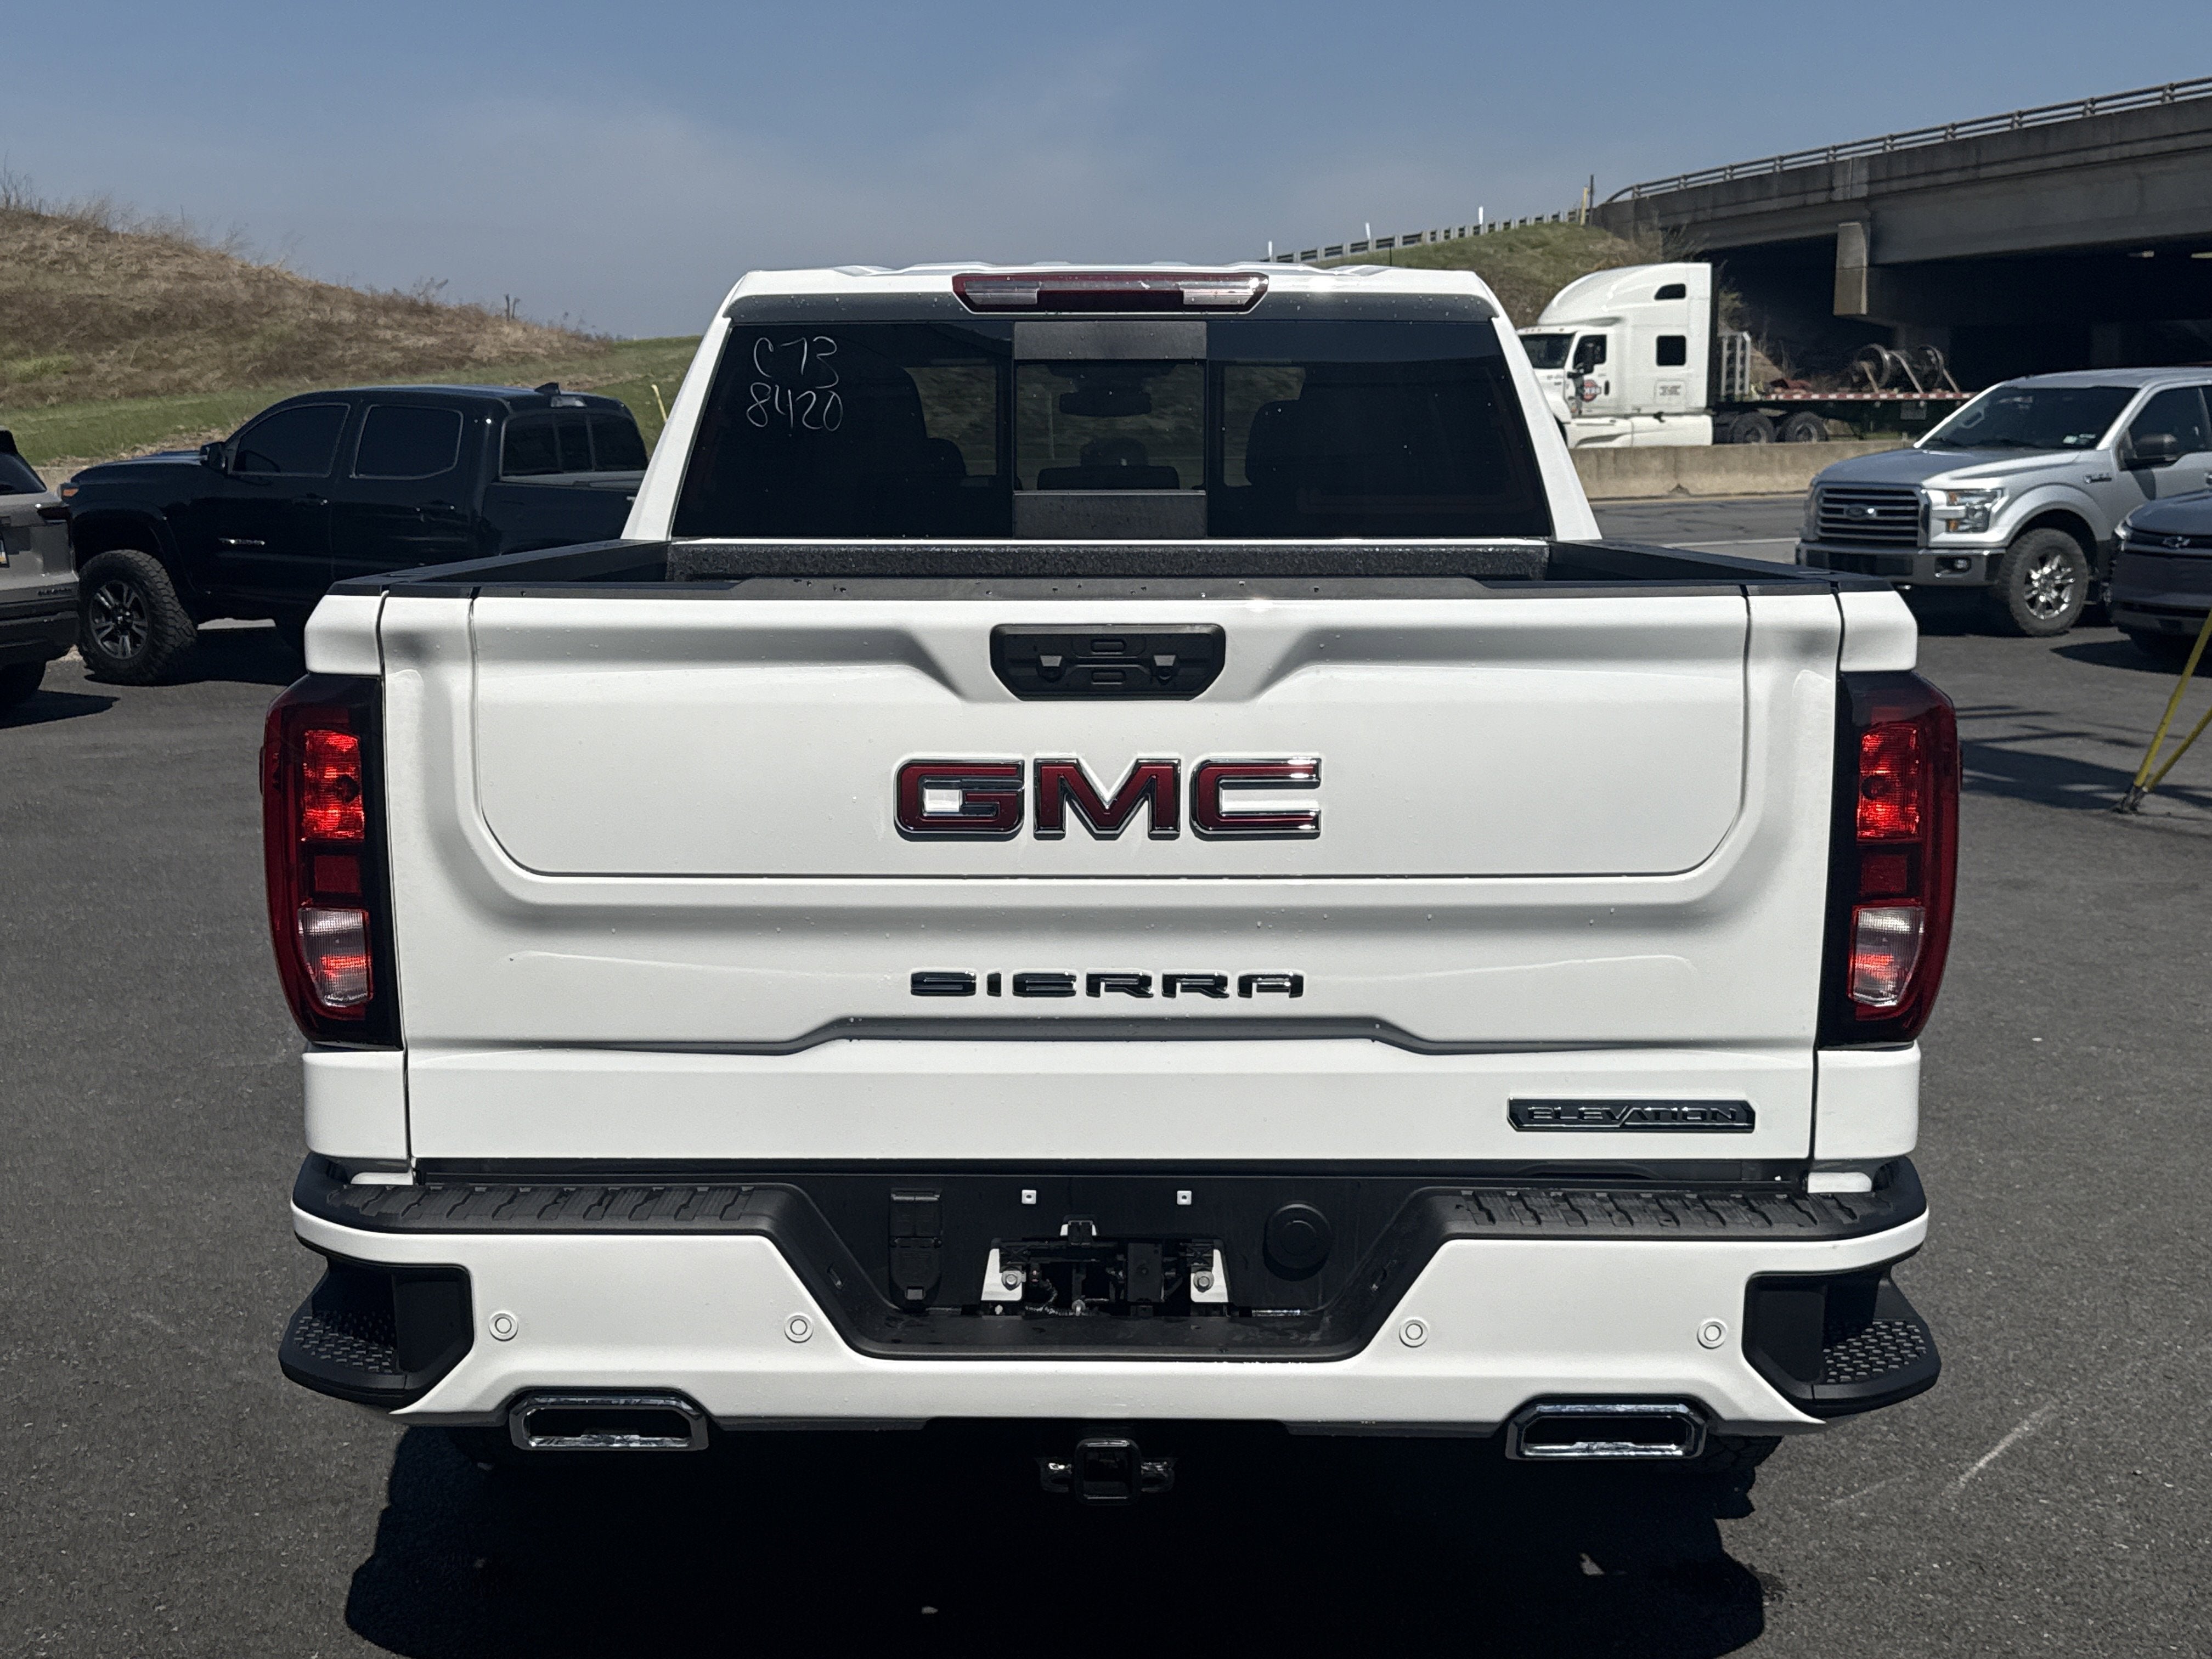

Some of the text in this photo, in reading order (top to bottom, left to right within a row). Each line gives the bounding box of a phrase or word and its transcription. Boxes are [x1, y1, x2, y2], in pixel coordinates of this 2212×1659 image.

[746, 382, 843, 431] 8420
[894, 758, 1322, 840] GMC
[910, 970, 1304, 998] SIERRA
[1527, 1106, 1737, 1121] ELEVATION
